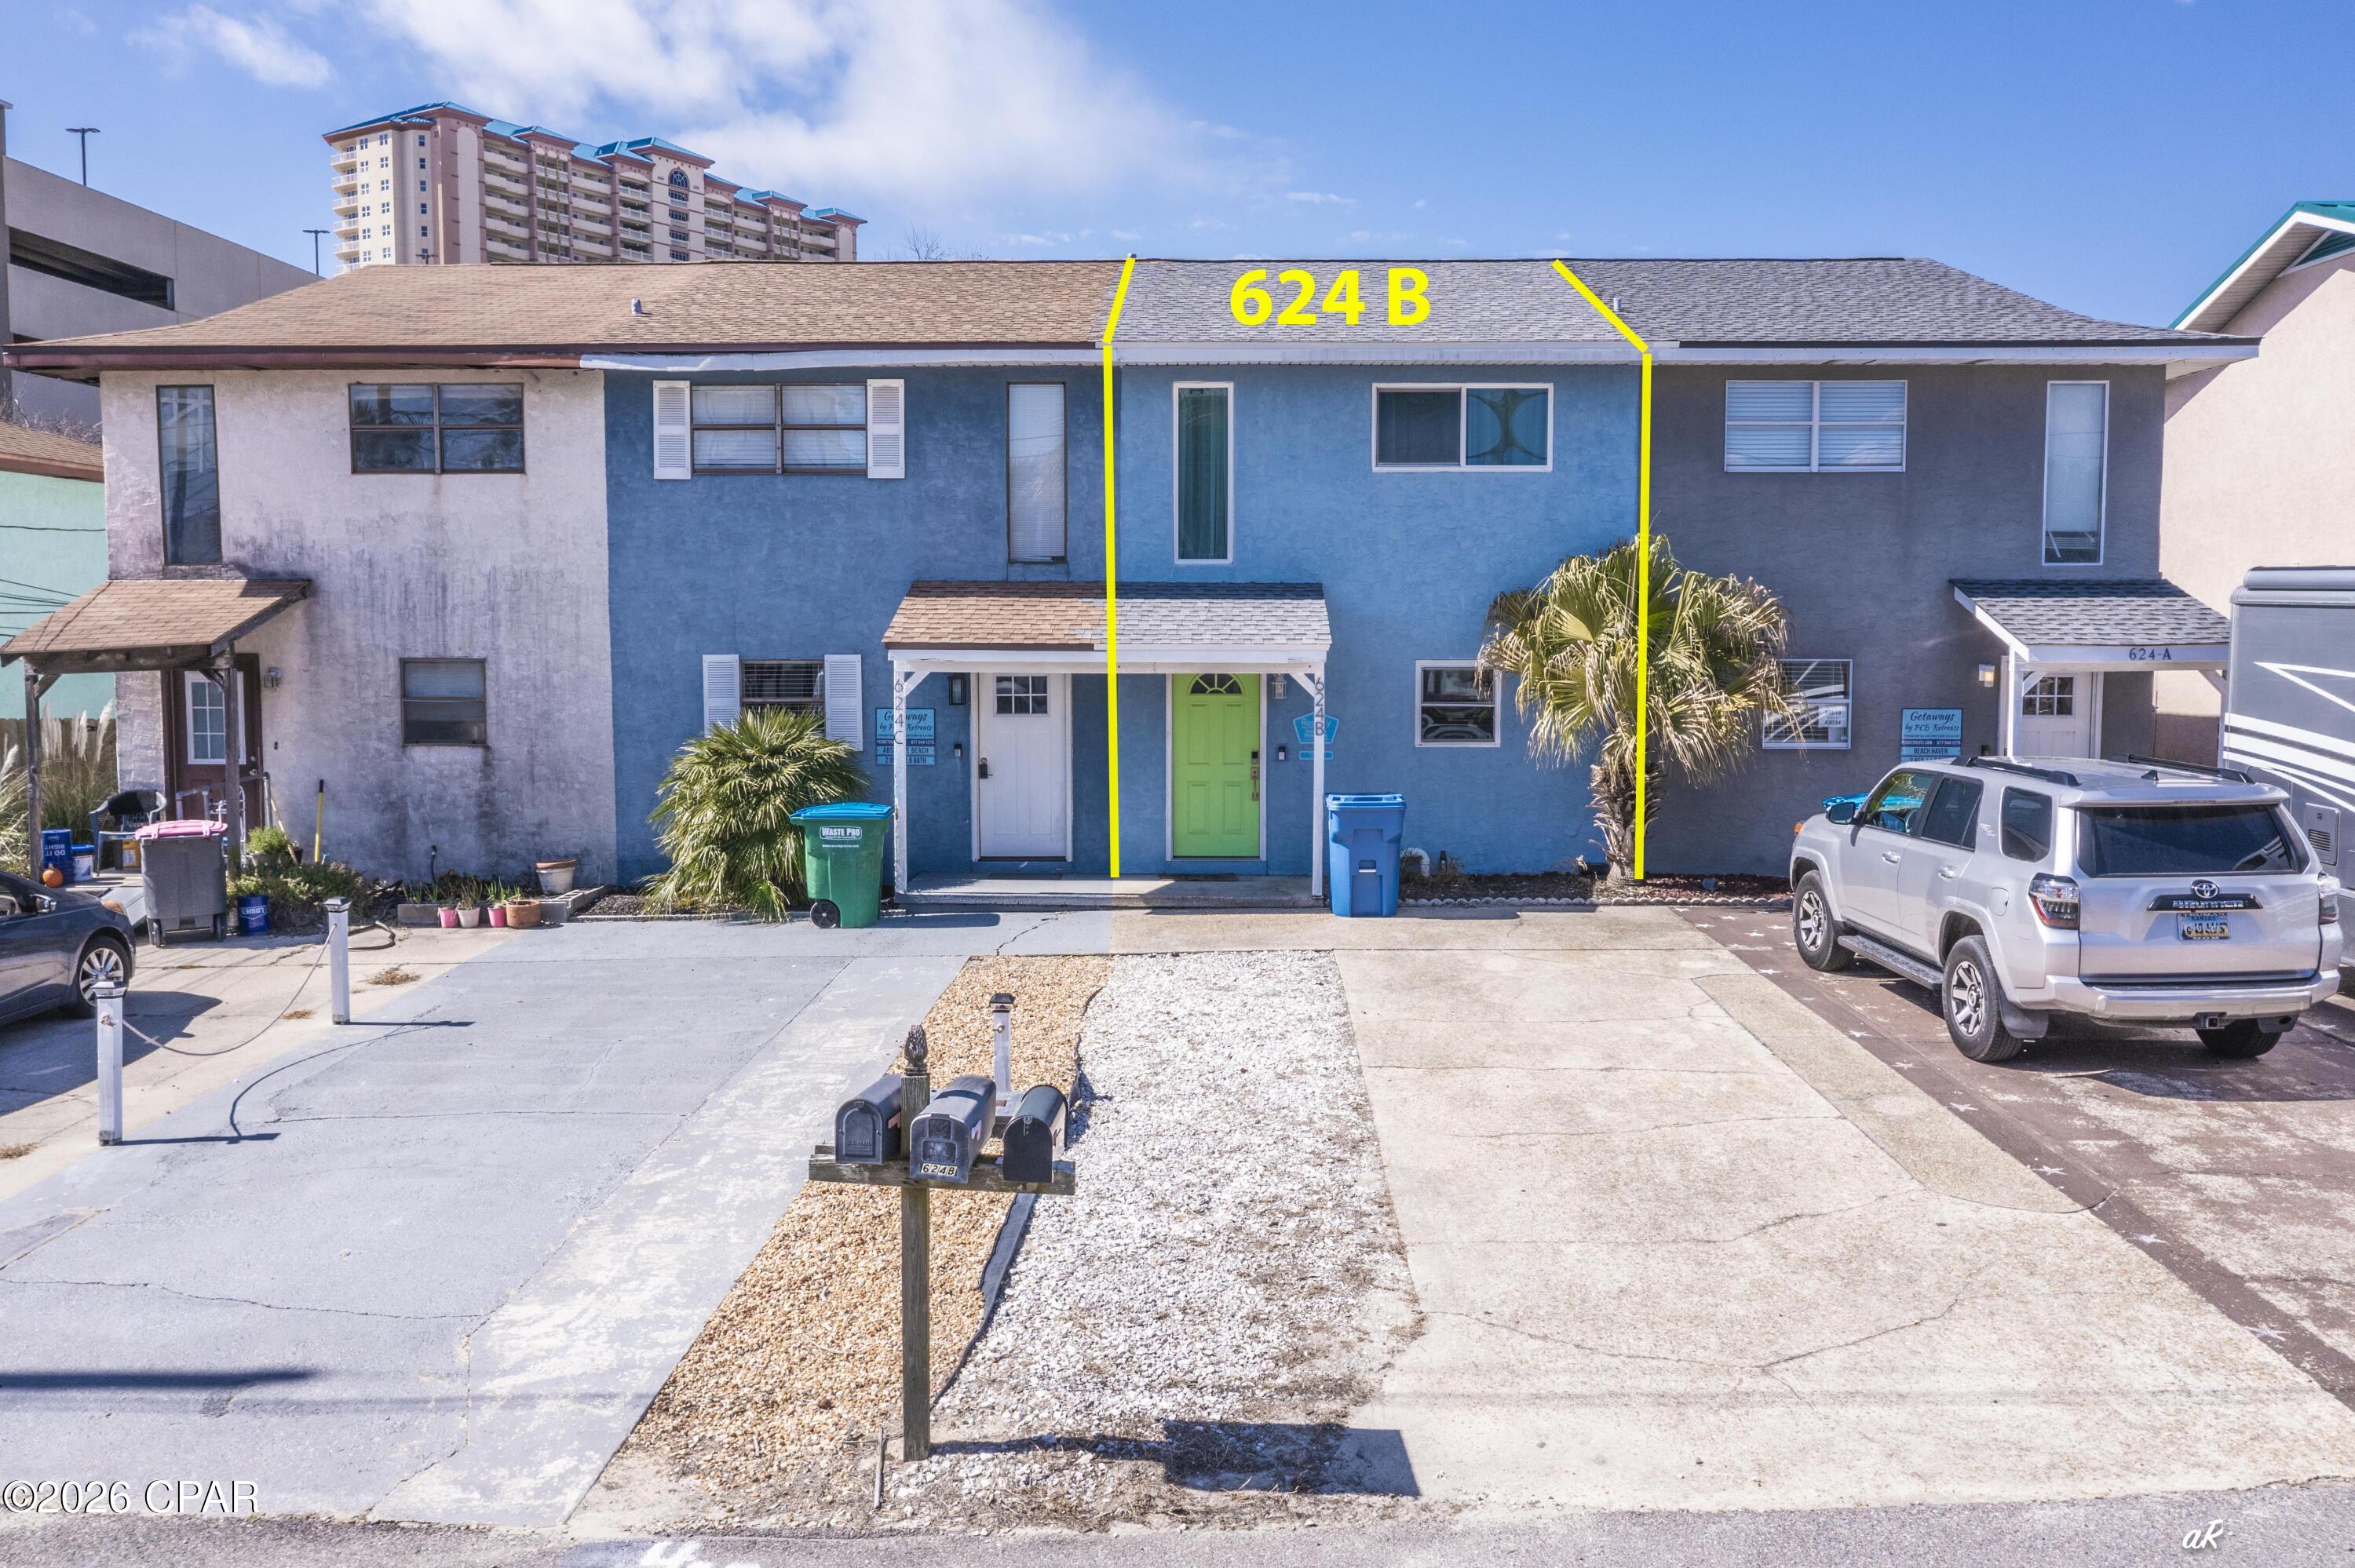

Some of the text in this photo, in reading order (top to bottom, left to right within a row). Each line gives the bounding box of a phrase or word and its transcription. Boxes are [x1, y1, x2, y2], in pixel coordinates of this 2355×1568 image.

[2129, 647, 2171, 660] 624-A
[894, 679, 904, 745] 624C
[1315, 677, 1325, 736] 624B
[1910, 710, 1955, 724] Getaways
[879, 723, 887, 731] by
[1904, 723, 1913, 732] by
[1933, 723, 1960, 732] Retreats
[822, 827, 860, 837] WASTE PRO
[923, 1165, 955, 1176] 624B
